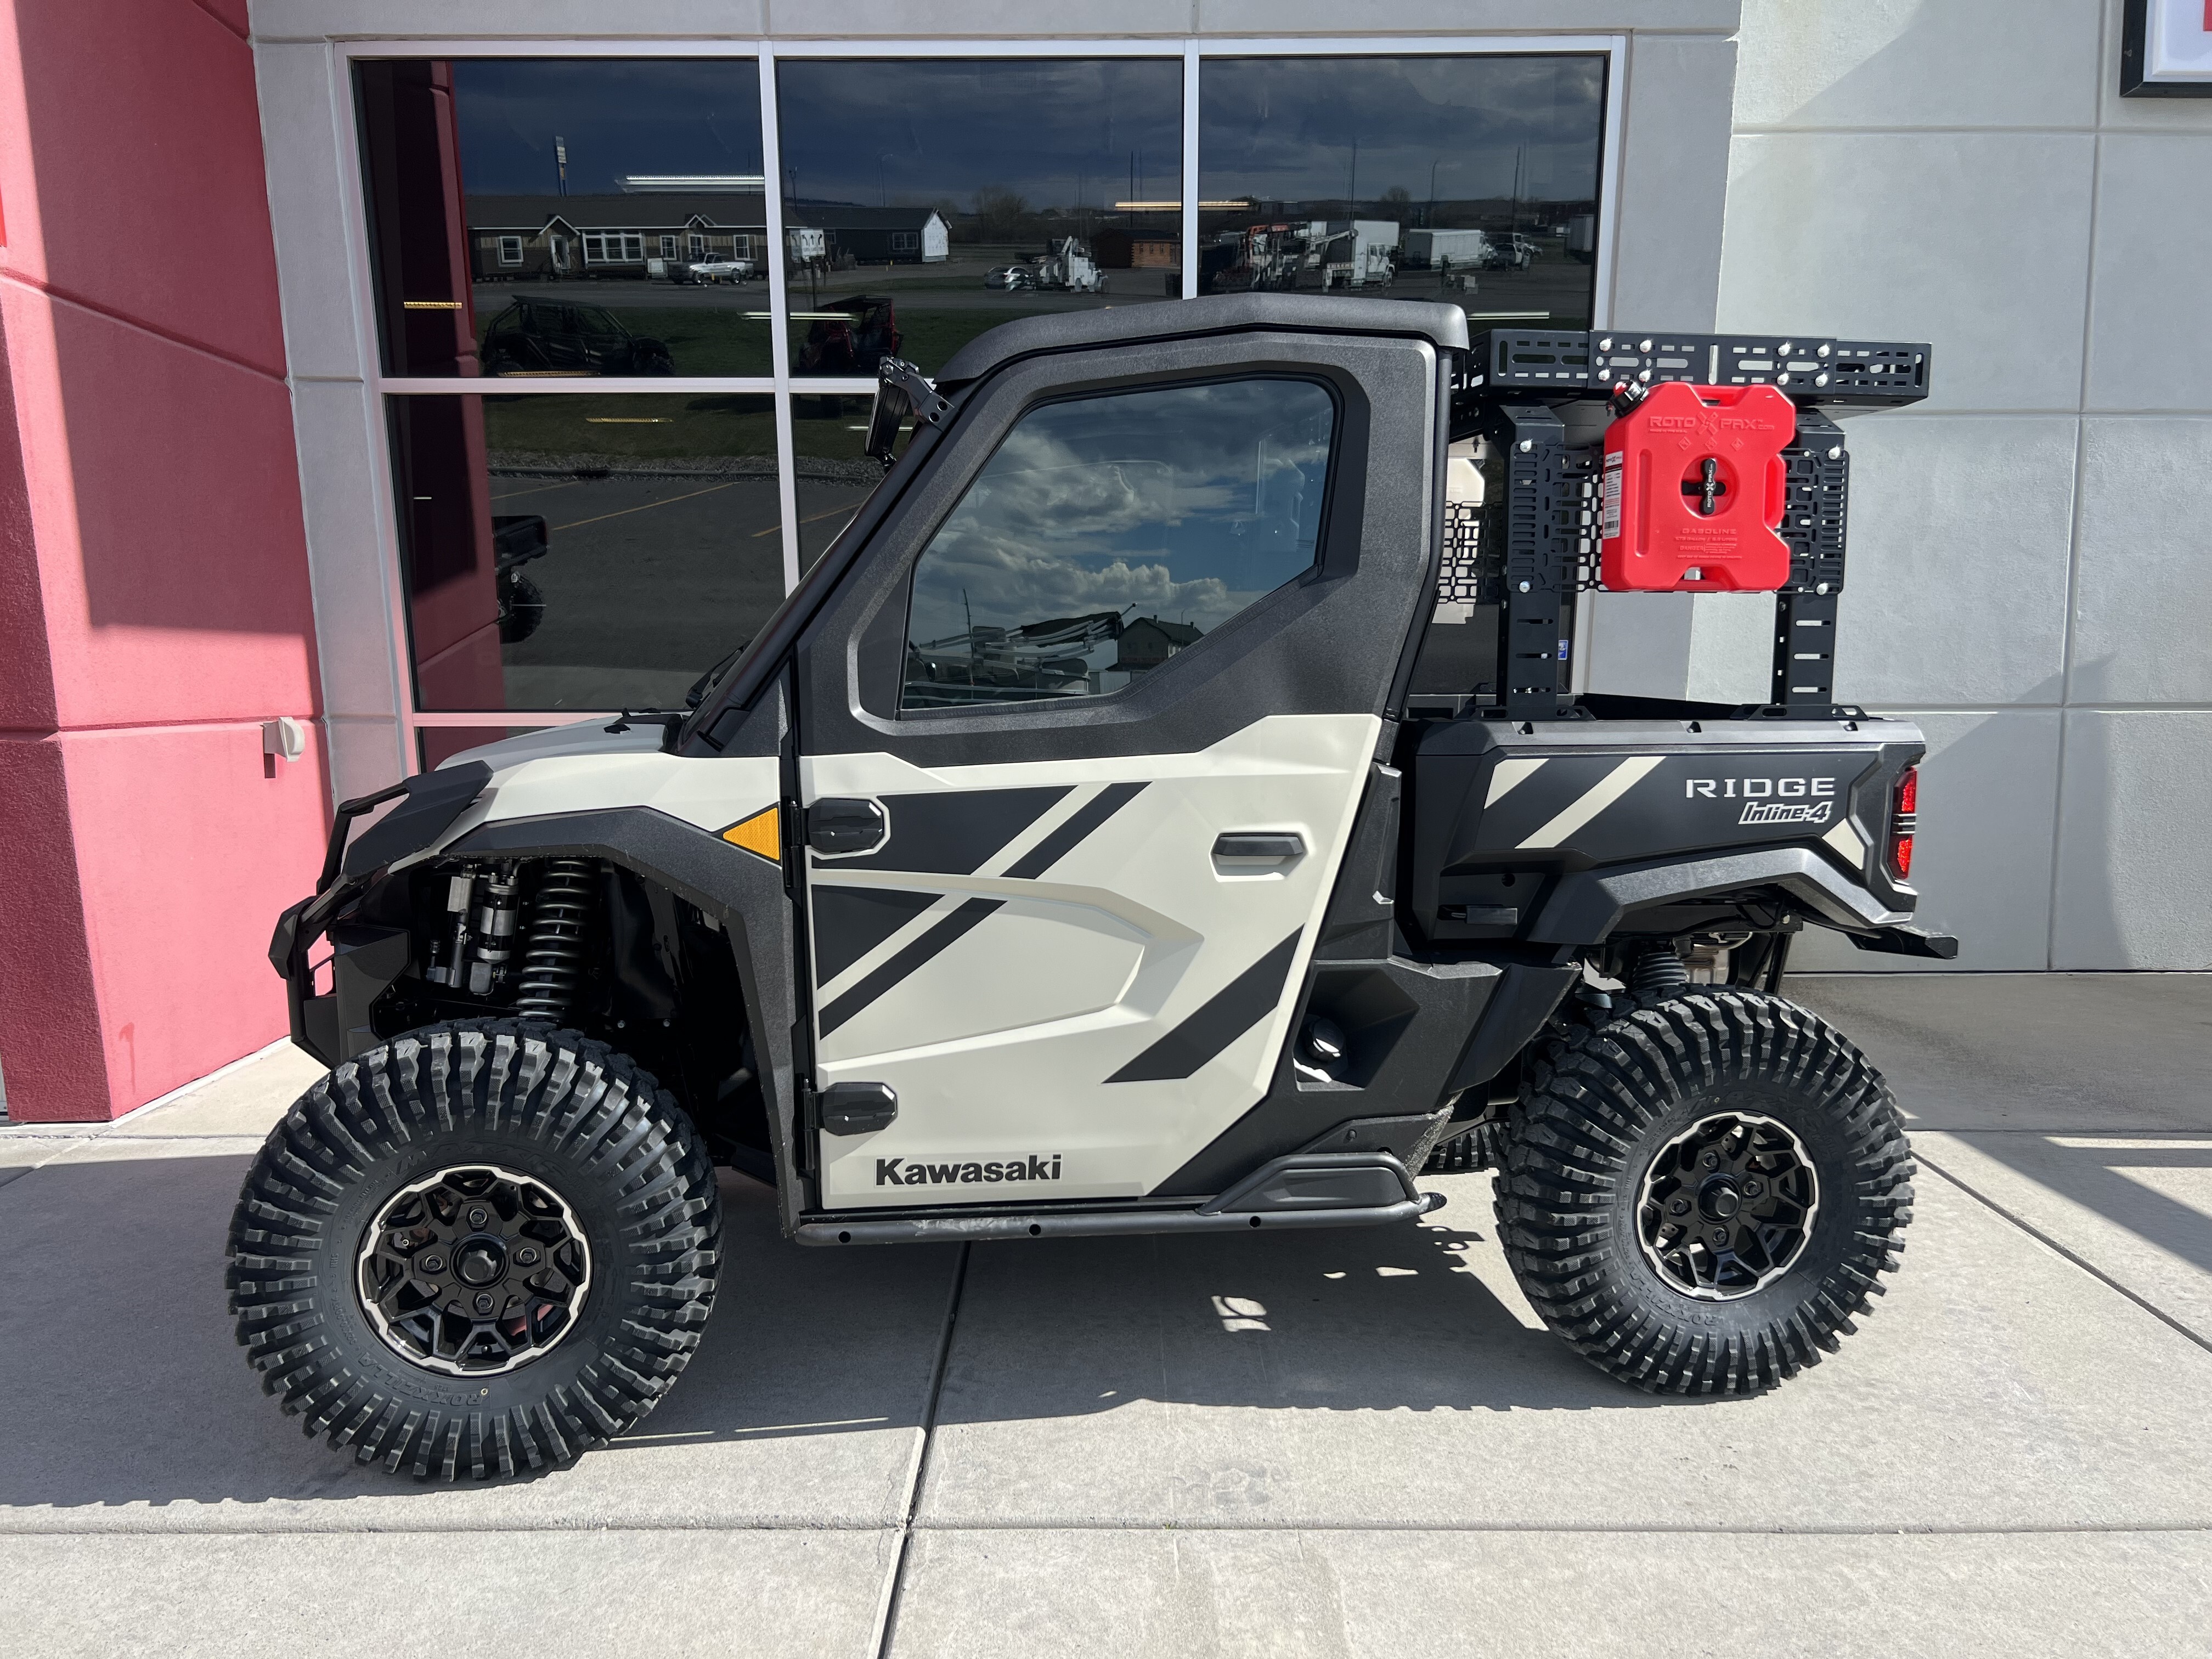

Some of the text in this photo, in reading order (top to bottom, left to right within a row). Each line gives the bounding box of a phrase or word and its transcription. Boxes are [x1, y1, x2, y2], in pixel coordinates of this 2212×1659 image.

[1649, 416, 1696, 427] ROTO
[1686, 777, 1836, 798] RIDGE
[1738, 800, 1834, 825] Inline-4
[396, 1142, 566, 1174] MAXXIS
[876, 1154, 1062, 1186] Kawasaki
[357, 1351, 482, 1406] ROXXZILLA
